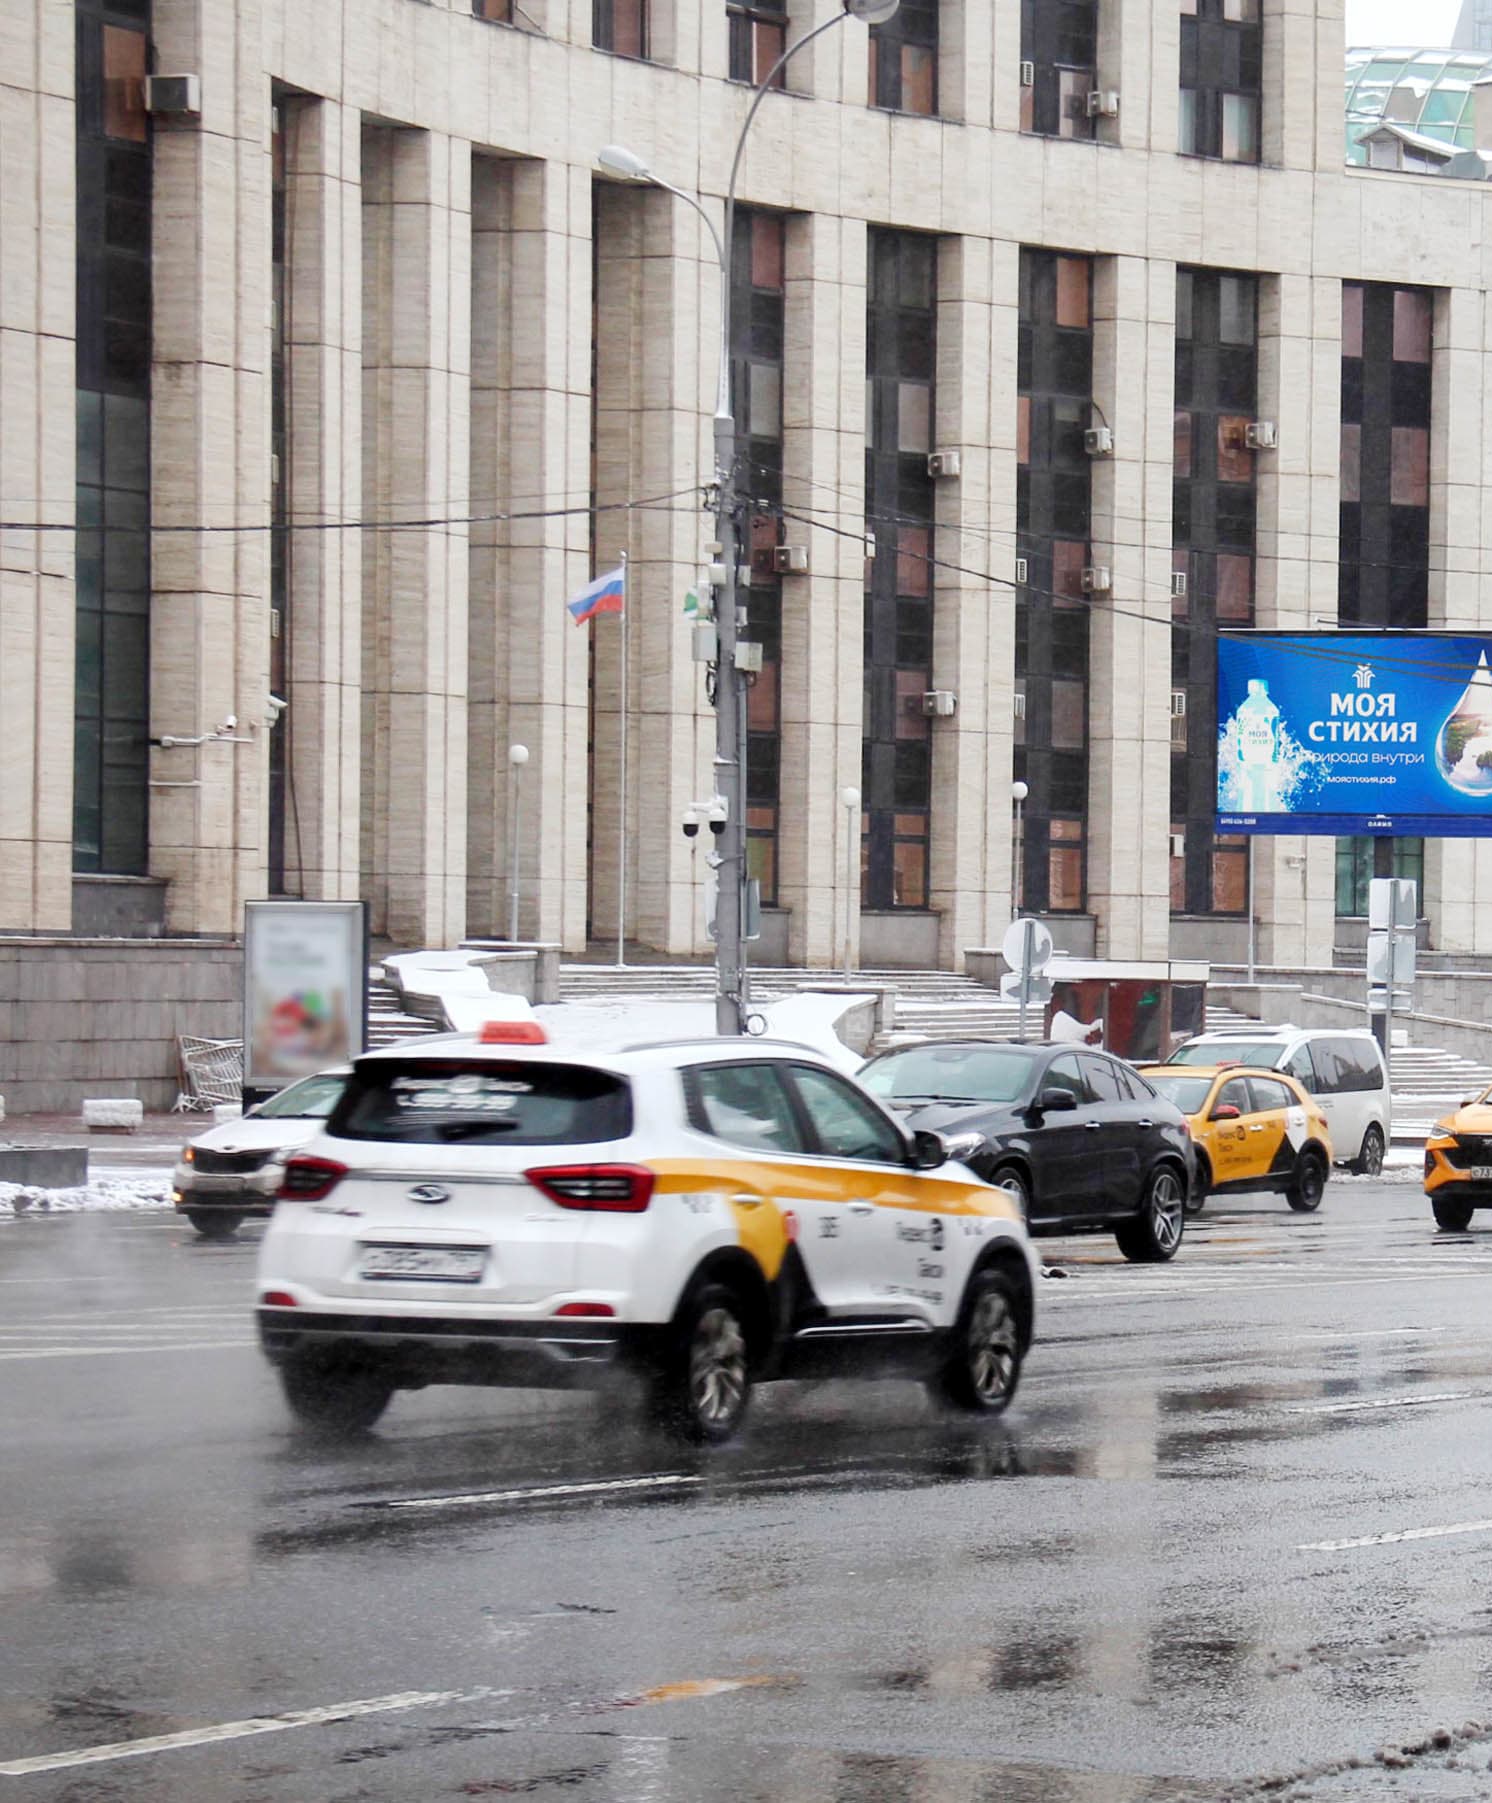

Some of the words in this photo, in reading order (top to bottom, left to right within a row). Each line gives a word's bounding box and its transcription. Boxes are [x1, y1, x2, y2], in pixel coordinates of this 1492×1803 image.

[1330, 692, 1396, 717] МОЯ
[1308, 721, 1417, 743] СТИХИЯ
[1371, 753, 1425, 766] внутри
